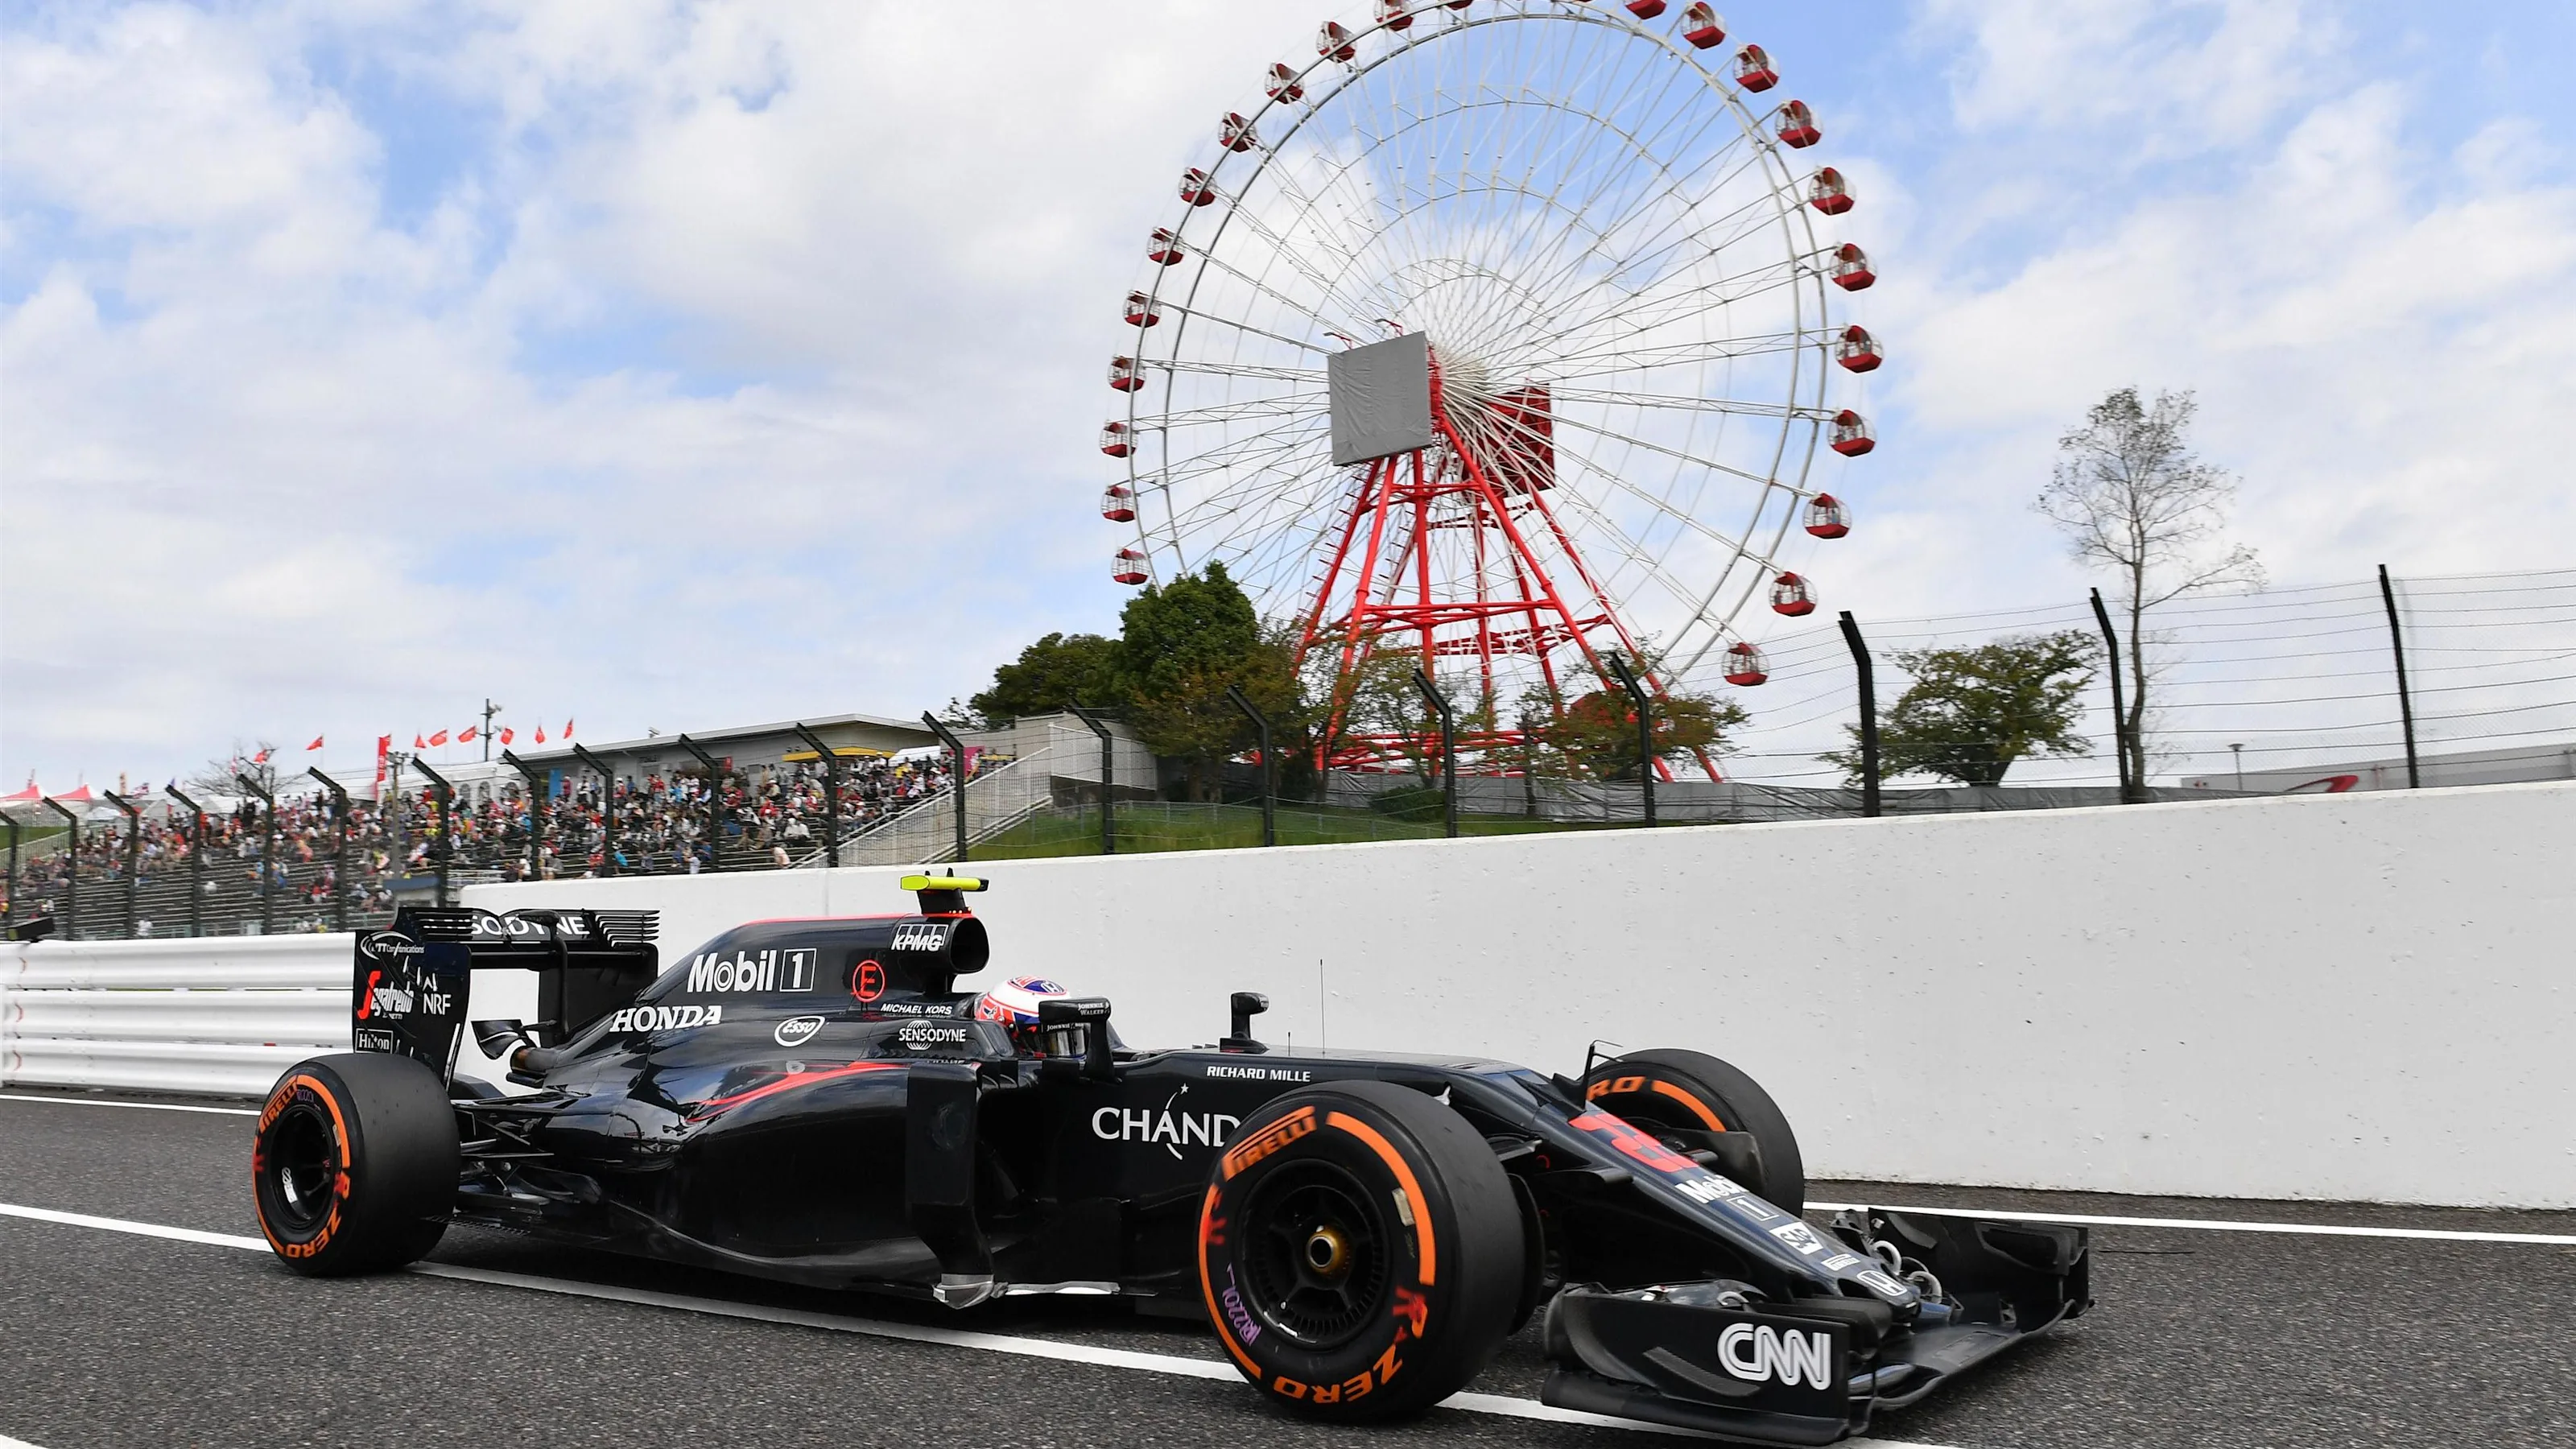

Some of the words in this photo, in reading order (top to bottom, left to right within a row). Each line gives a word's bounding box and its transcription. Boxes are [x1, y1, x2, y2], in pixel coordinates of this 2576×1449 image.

[891, 934, 943, 952] KPMG
[687, 950, 777, 993] Mobil
[791, 952, 804, 989] 1
[423, 993, 452, 1015] NRF
[880, 1003, 923, 1014] MICHAEL
[925, 1005, 953, 1015] KORS
[609, 1005, 722, 1032] HONDA
[898, 1028, 967, 1042] SENSODYNE
[1207, 1066, 1265, 1080] RICHARD
[1269, 1068, 1311, 1082] MILLE
[1221, 1105, 1317, 1182] PIRELLI
[1780, 1228, 1817, 1249] SAP
[1717, 1322, 1832, 1391] CNN
[1274, 1344, 1403, 1404] ZERO
